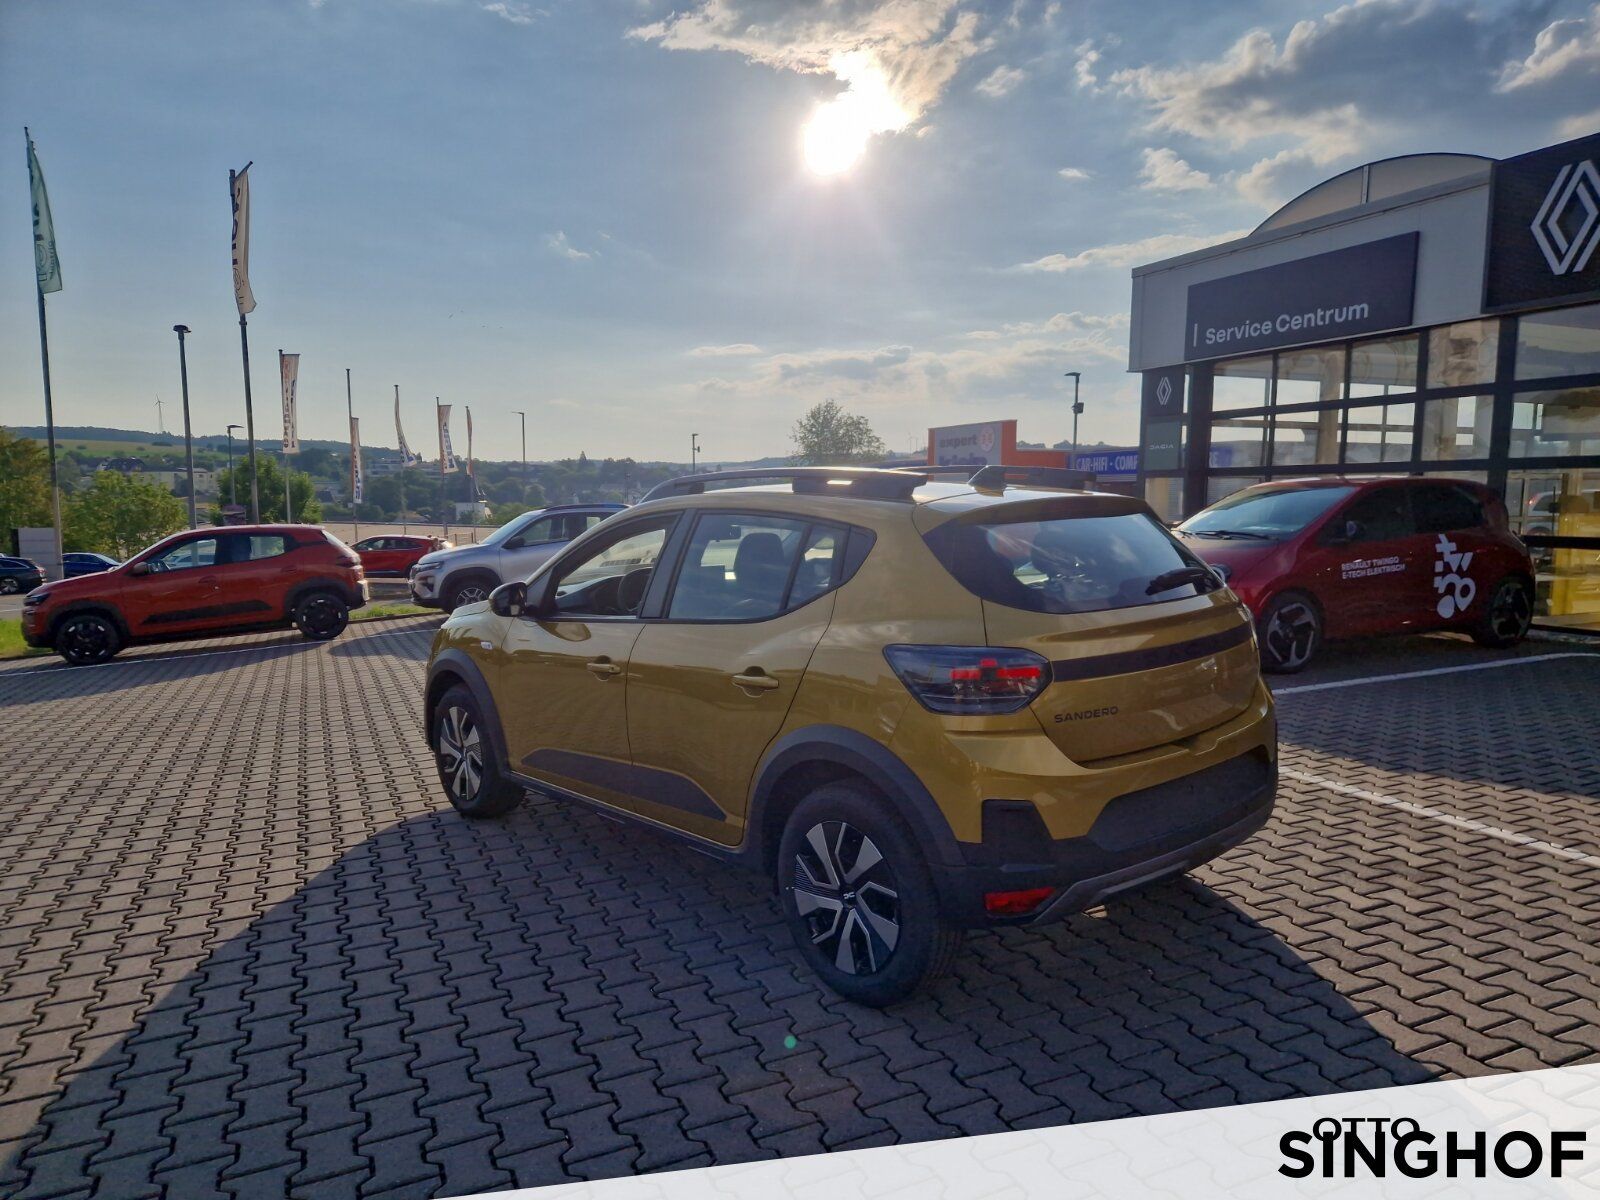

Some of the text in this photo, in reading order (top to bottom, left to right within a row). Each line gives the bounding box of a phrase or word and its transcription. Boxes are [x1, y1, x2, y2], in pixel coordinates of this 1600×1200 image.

[1205, 303, 1369, 344] Service Centrum
[940, 434, 978, 450] expert
[1341, 556, 1400, 571] RENAULT TWINGO
[1342, 570, 1366, 580] E-TECH
[1054, 706, 1119, 723] SANDERO
